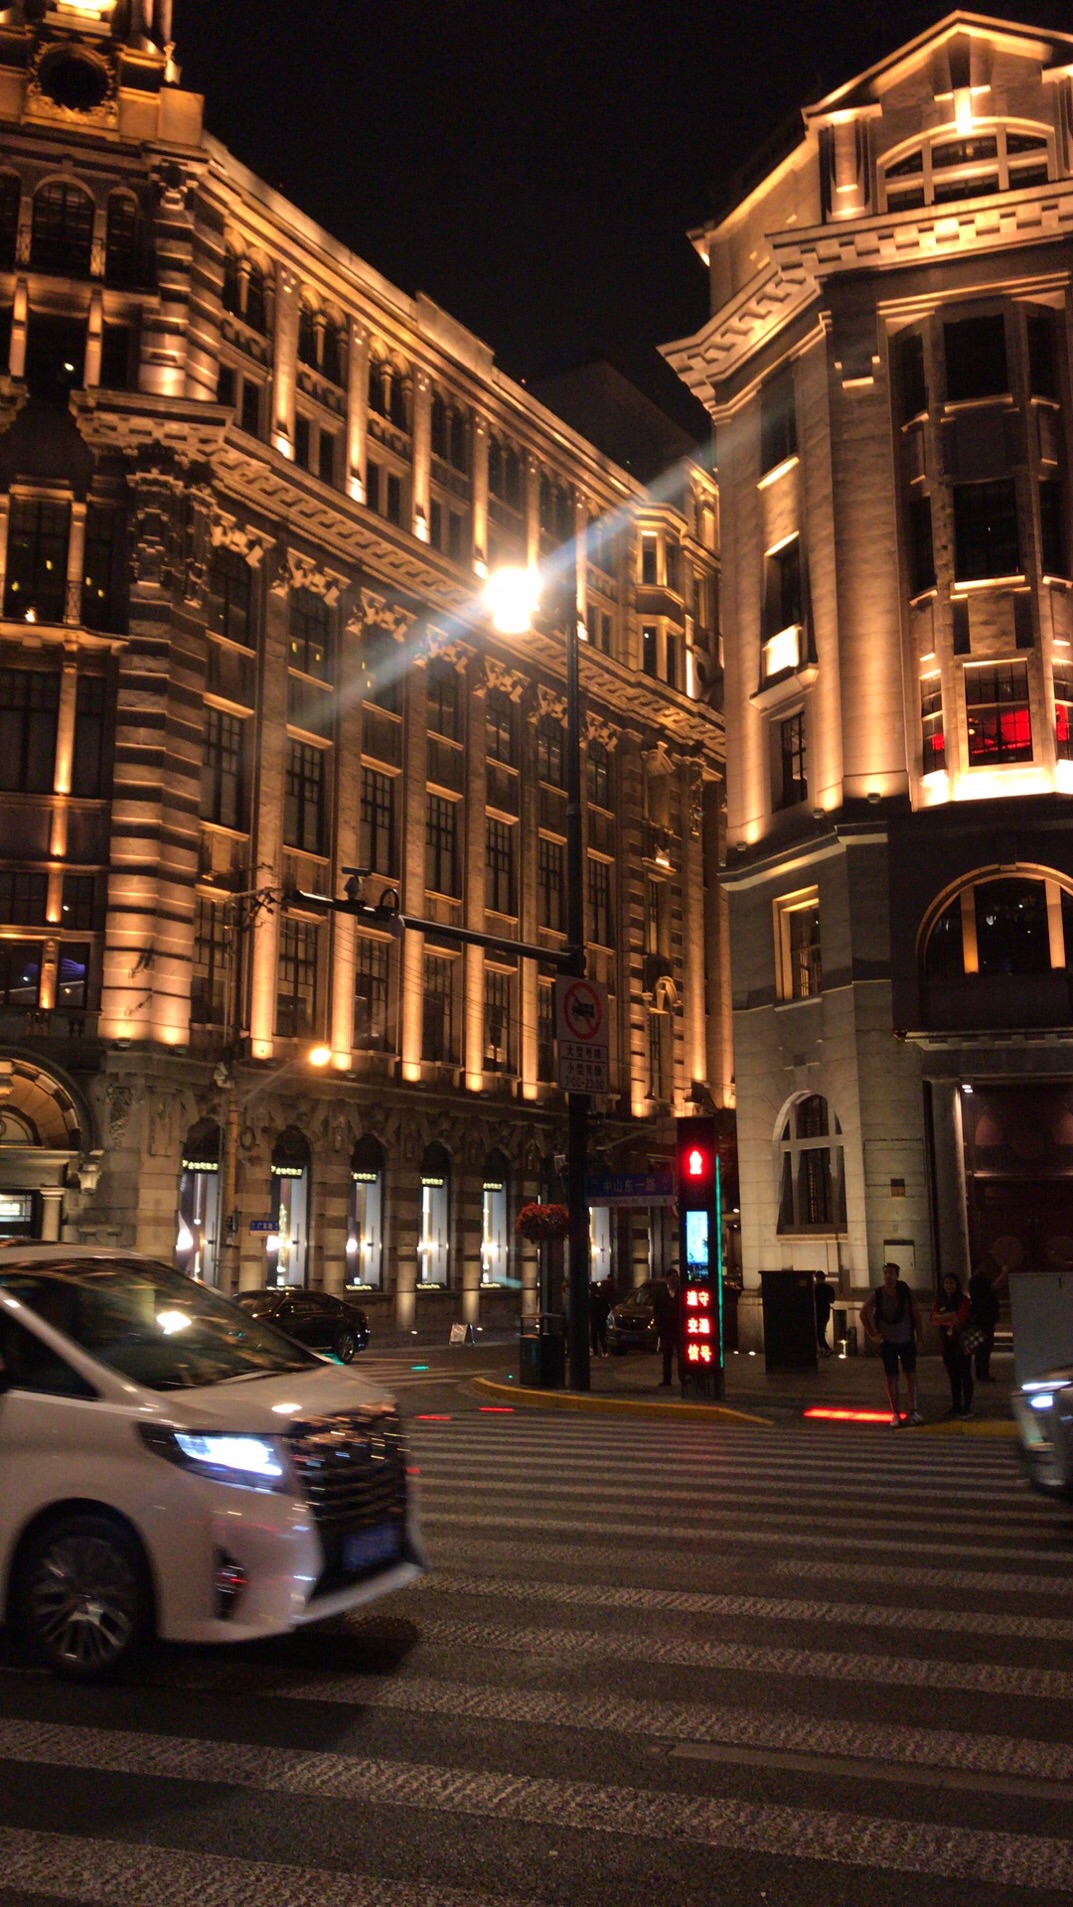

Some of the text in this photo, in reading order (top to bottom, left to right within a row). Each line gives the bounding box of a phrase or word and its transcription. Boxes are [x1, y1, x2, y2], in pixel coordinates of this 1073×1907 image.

[602, 1177, 657, 1193] 中山东一路
[686, 1290, 710, 1307] 遵守
[687, 1317, 711, 1334] 交通
[687, 1344, 712, 1363] 信号
